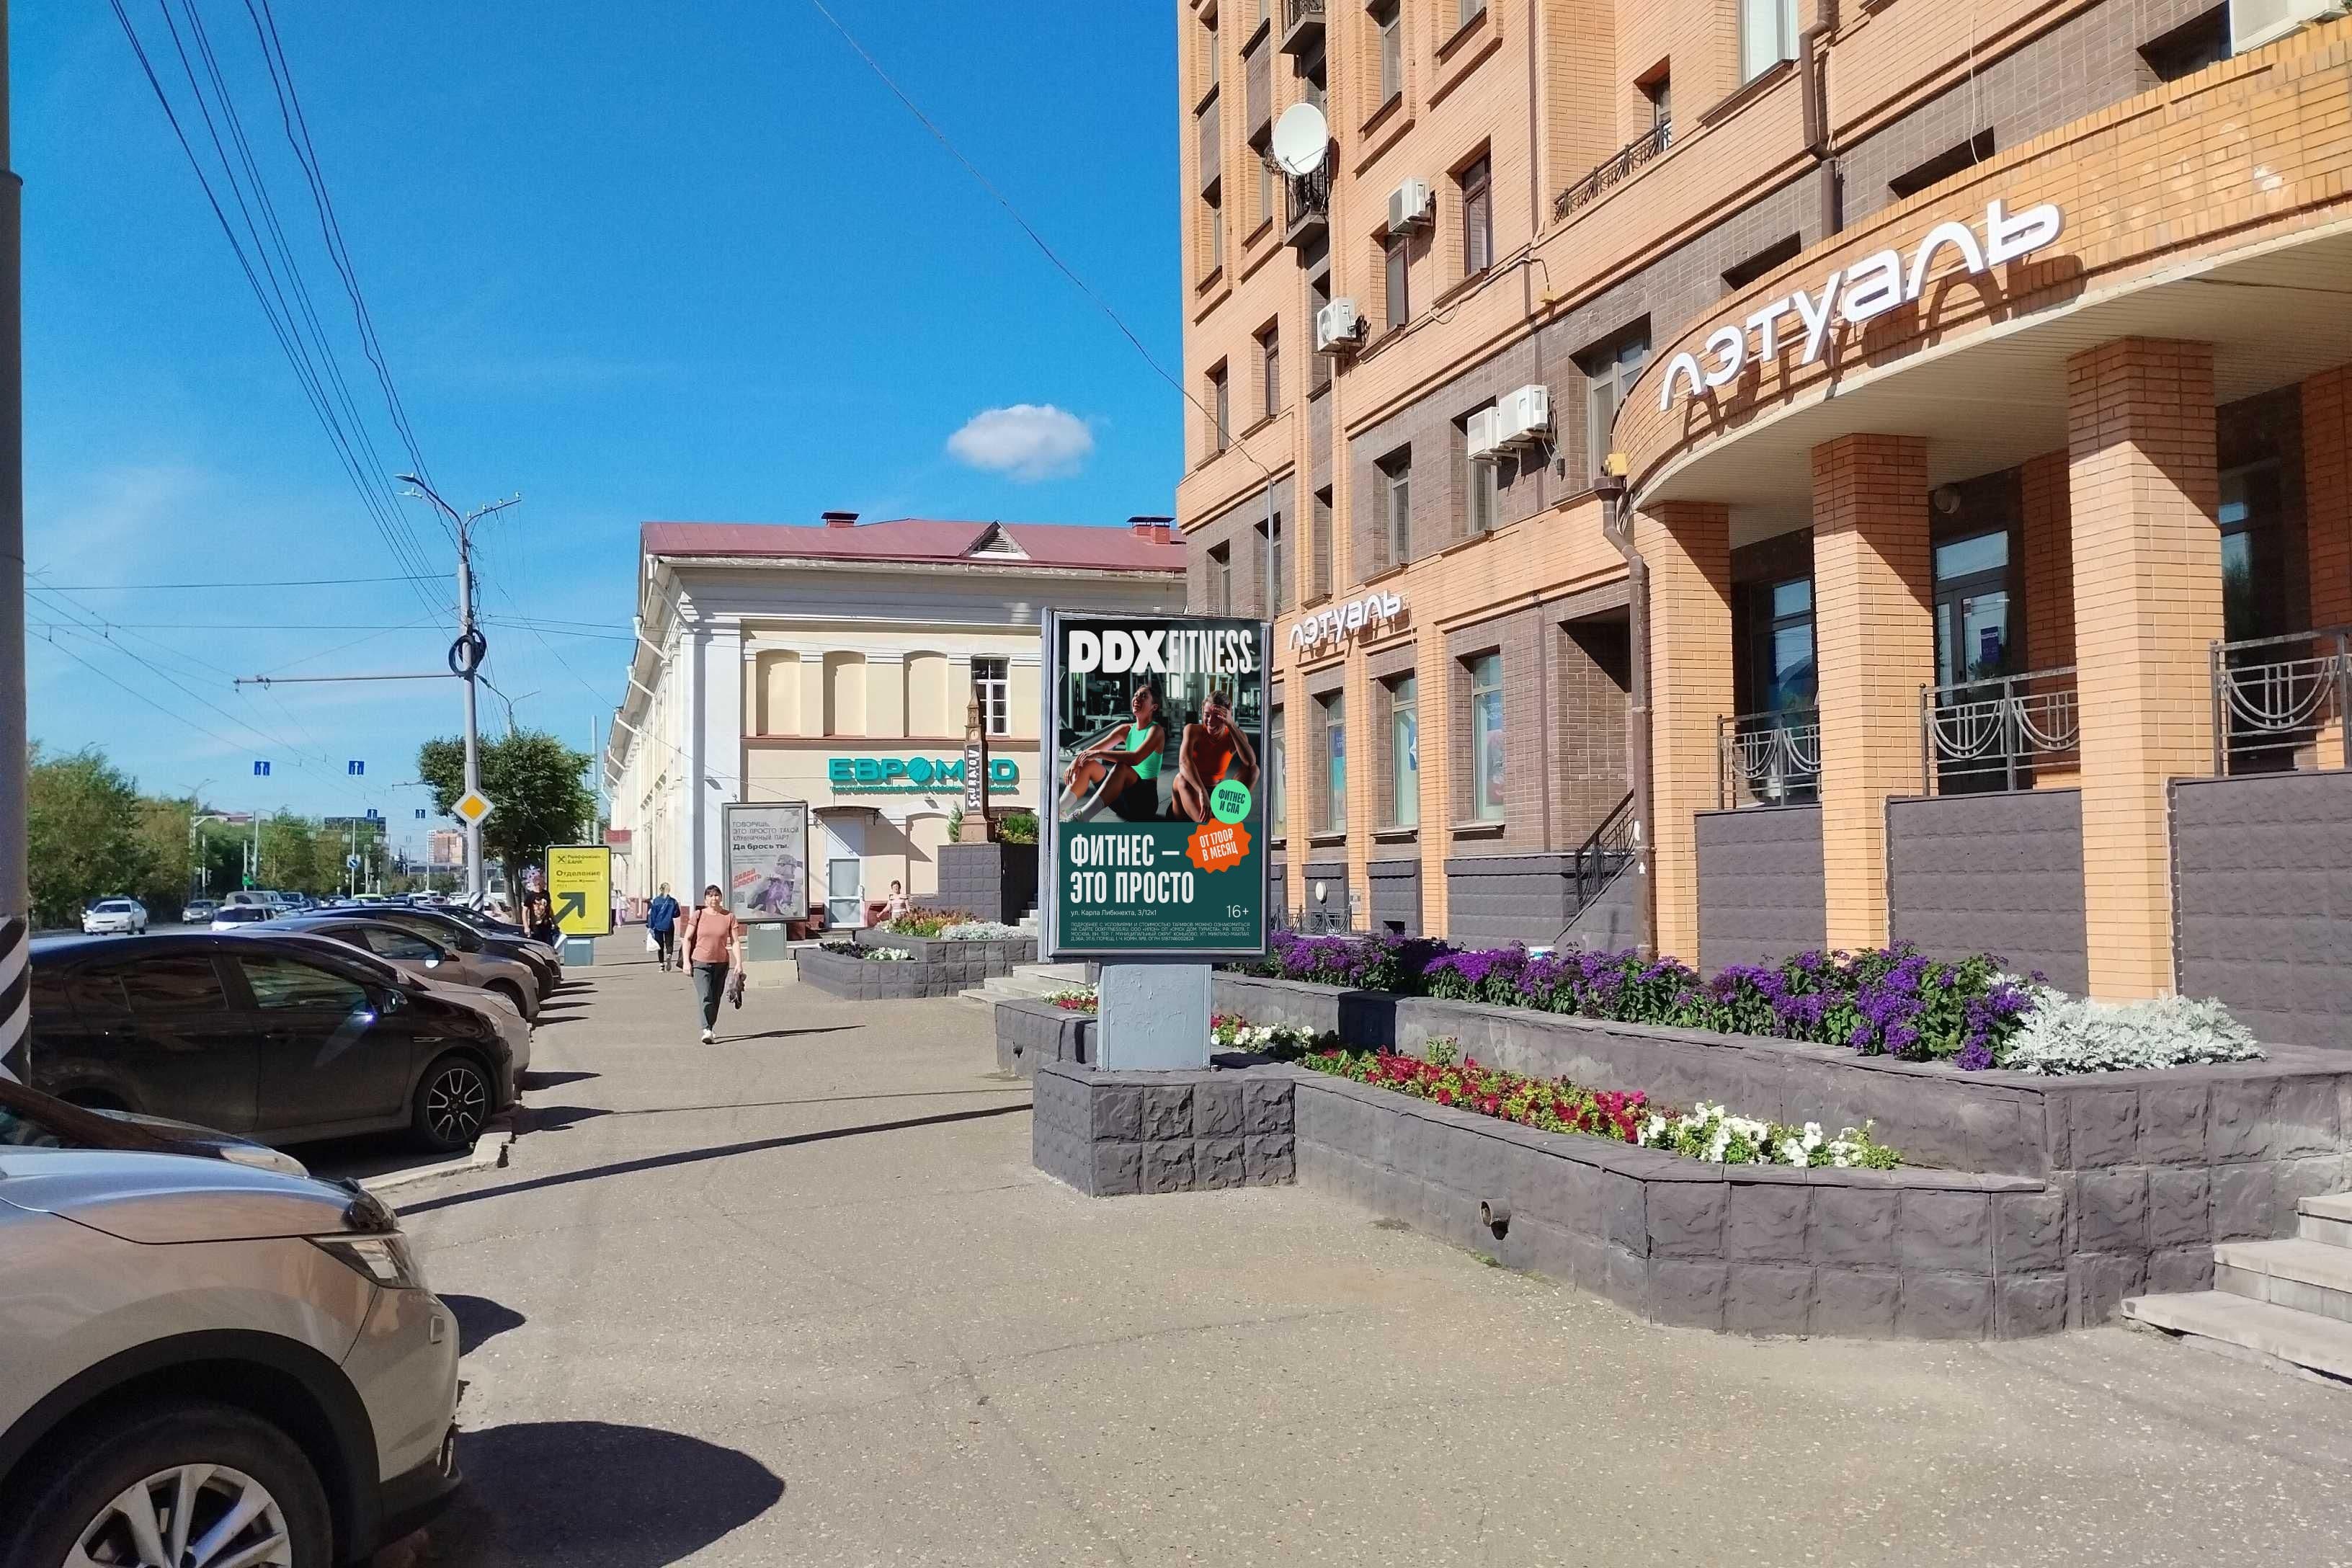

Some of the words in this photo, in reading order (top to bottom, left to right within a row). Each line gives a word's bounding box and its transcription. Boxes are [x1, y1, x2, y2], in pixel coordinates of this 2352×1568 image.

[1219, 789, 1246, 803] ФИТНЕС
[1219, 801, 1226, 811] И
[1226, 802, 1240, 814] СПА
[1199, 834, 1210, 847] ОТ
[1070, 834, 1154, 867] ФИТНЕС
[1202, 849, 1209, 861] В
[1209, 841, 1239, 859] МЕСЯЦ
[1070, 871, 1107, 904] ЭТО
[1115, 871, 1194, 904] ПРОСТО
[1226, 904, 1250, 918] 16+
